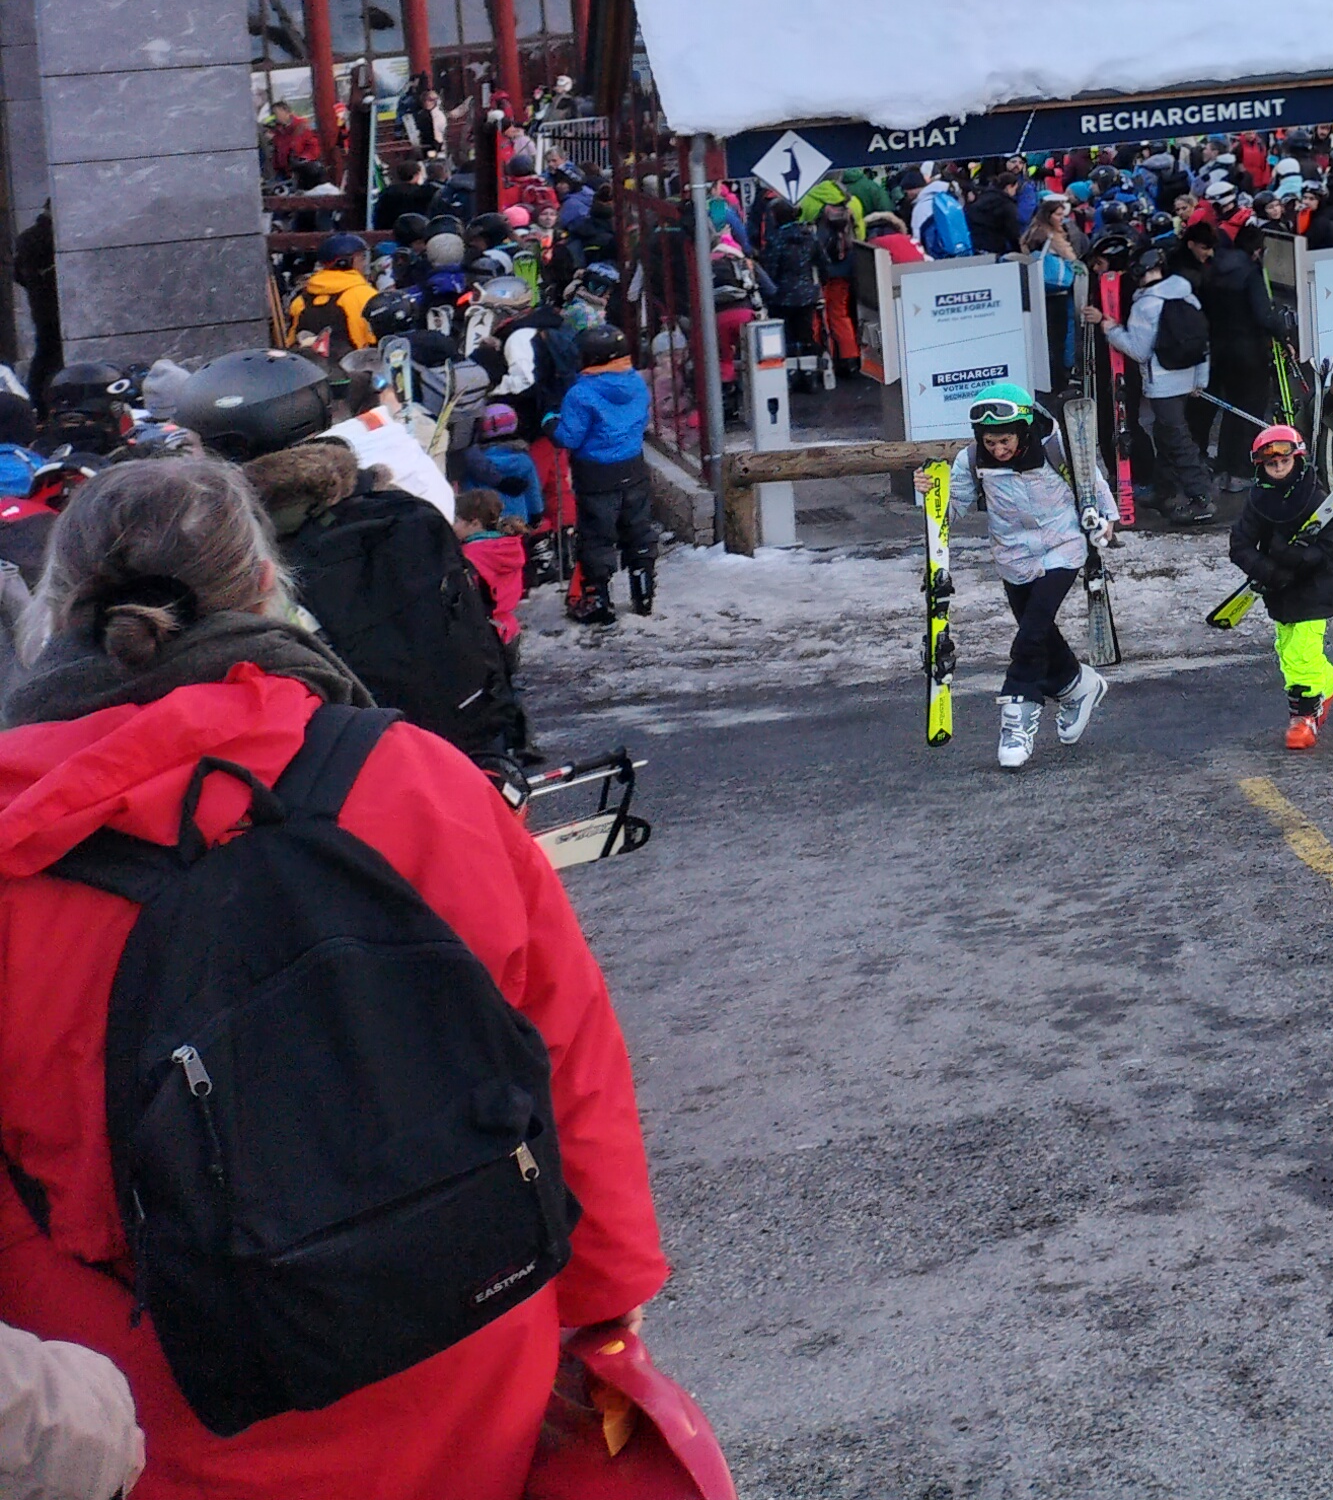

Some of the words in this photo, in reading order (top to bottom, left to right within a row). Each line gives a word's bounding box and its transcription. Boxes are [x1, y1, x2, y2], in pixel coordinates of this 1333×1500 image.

[1080, 98, 1286, 135] RECHARGEMENT
[867, 126, 960, 153] ACHAT
[932, 307, 962, 317] VOTRE
[964, 300, 1000, 312] FORFAIT
[937, 290, 990, 305] ACHETEZ
[937, 366, 1004, 384] RECHARGEZ
[943, 384, 969, 392] VOTRE
[934, 476, 942, 519] HEAD
[474, 1260, 537, 1303] EASTPAK
